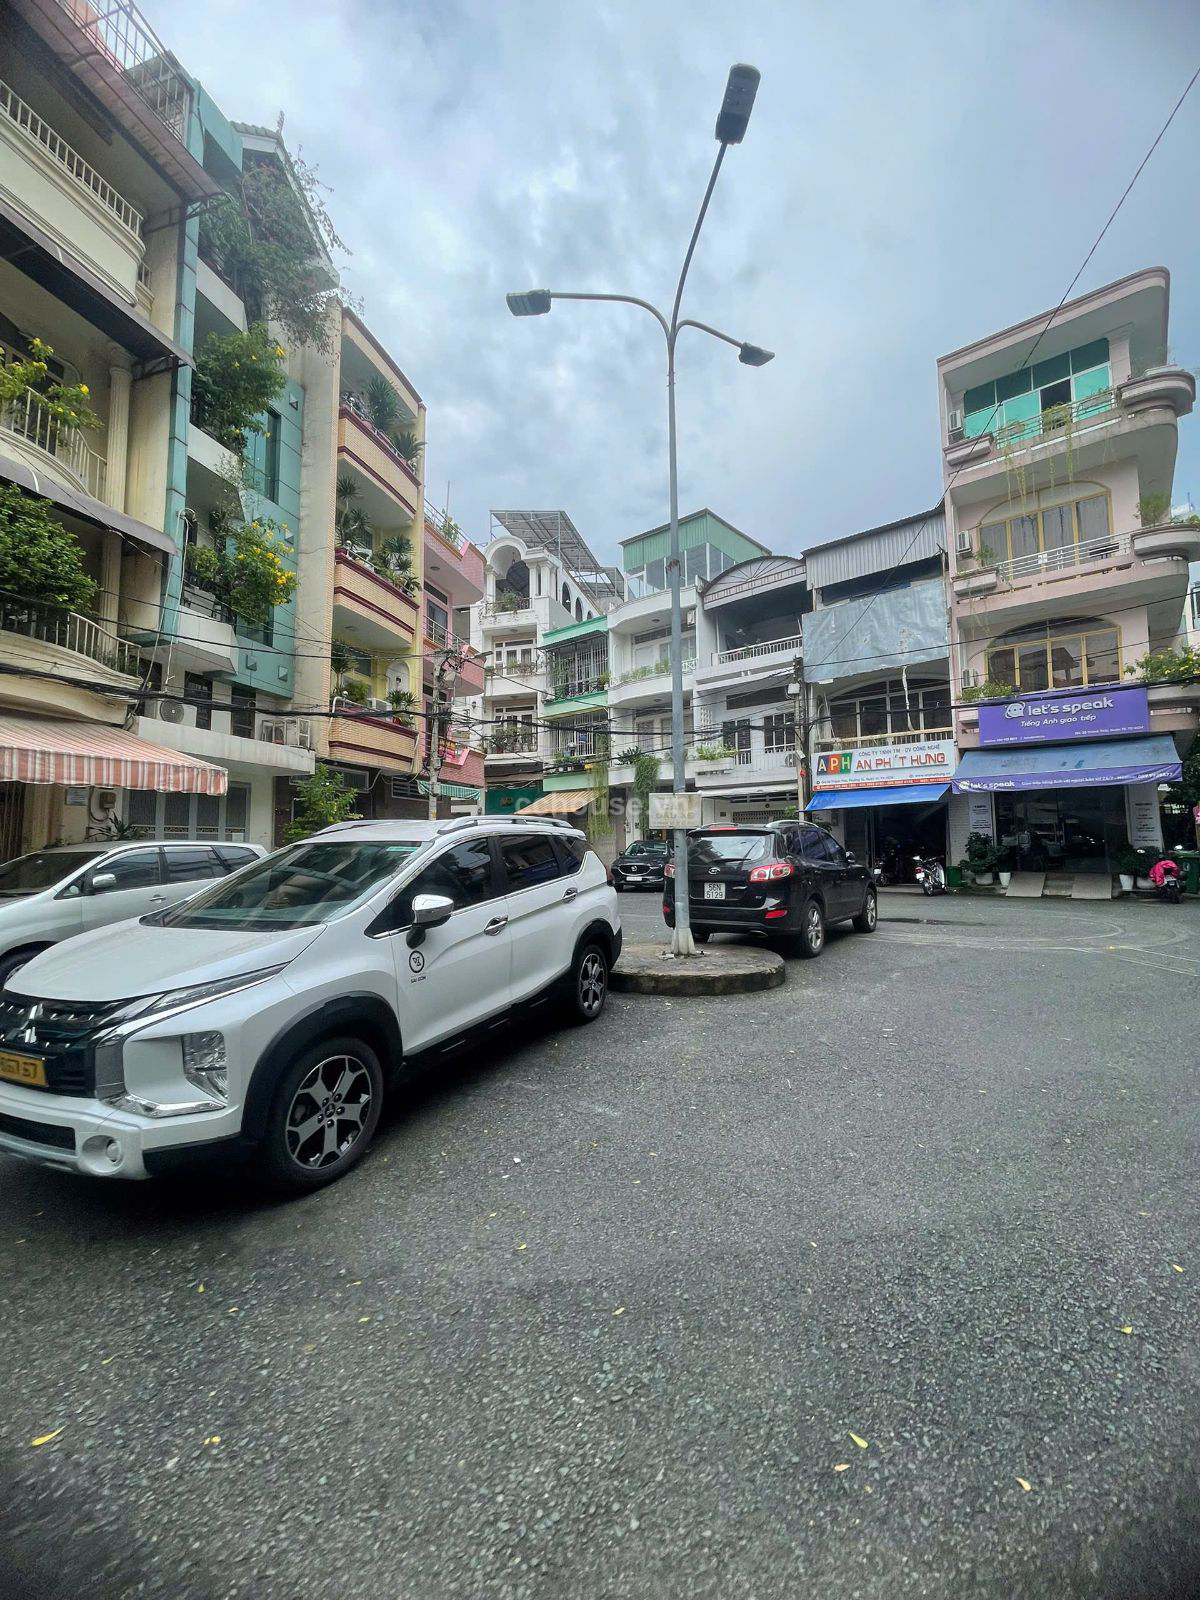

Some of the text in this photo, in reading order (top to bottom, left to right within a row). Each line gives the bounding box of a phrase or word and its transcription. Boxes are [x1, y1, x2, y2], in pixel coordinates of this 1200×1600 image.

[1028, 697, 1114, 716] let's speak
[1060, 717, 1078, 725] giao
[856, 759, 872, 770] AN
[988, 780, 1015, 789] speak
[706, 891, 723, 899] 5129
